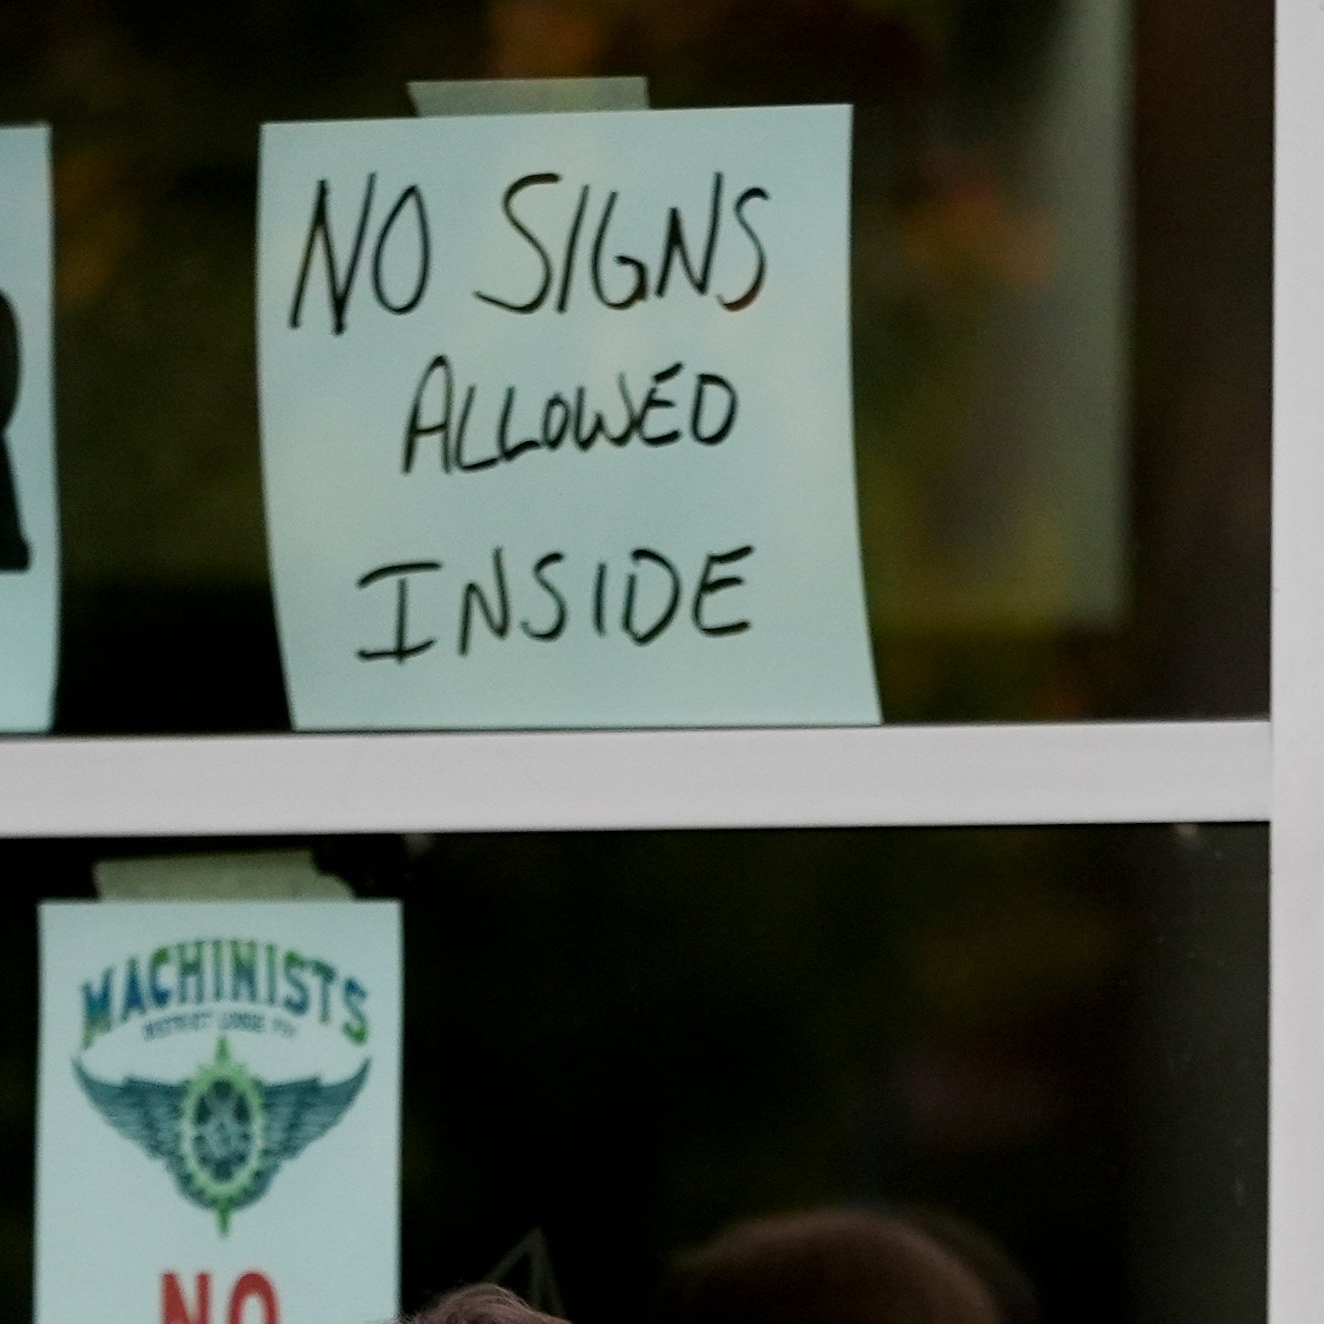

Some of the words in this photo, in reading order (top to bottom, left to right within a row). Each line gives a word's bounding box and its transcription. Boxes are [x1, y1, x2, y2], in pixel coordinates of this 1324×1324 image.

[288, 172, 432, 336] NO
[474, 171, 771, 315] SIGNS
[402, 354, 739, 475] ALLOWED
[356, 545, 756, 665] INSIDE
[80, 937, 371, 1050] MACHINISTS
